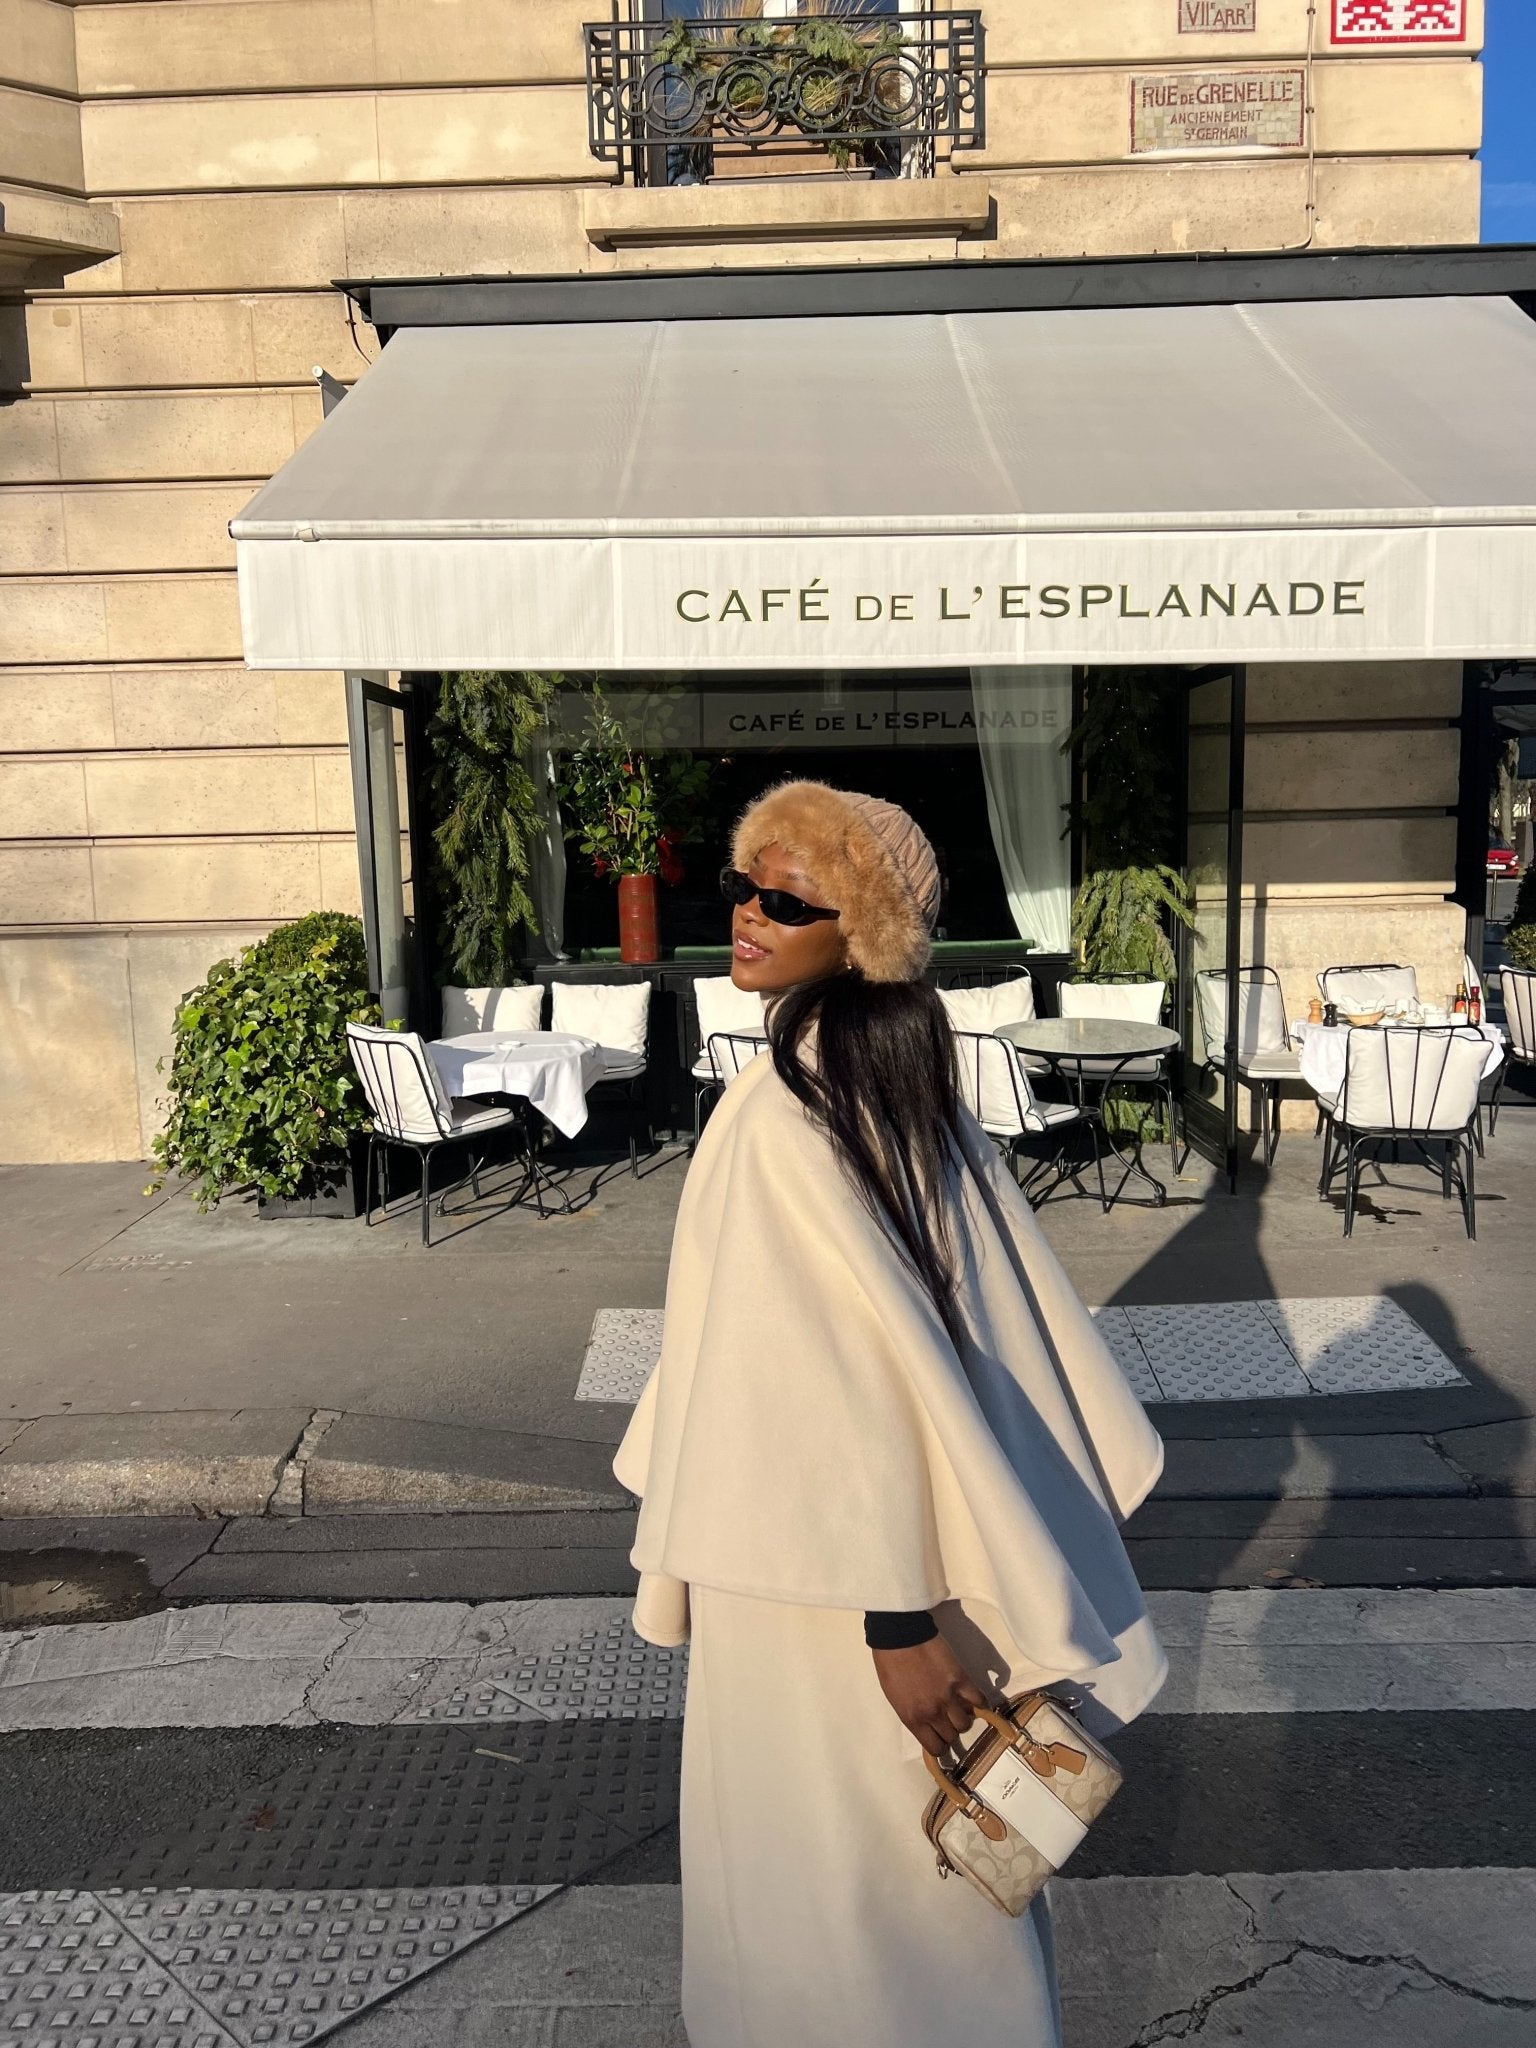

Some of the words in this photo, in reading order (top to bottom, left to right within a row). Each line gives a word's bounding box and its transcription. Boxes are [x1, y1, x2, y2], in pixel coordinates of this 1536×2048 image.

[1142, 85, 1178, 108] RUE
[1180, 93, 1195, 105] DE
[1196, 81, 1294, 104] GRENELLE
[1170, 109, 1263, 125] ANCIENNEMENT
[676, 578, 830, 623] CAFÉ
[855, 594, 914, 621] DE
[728, 709, 804, 732] CAFÉ
[815, 716, 845, 731] DE
